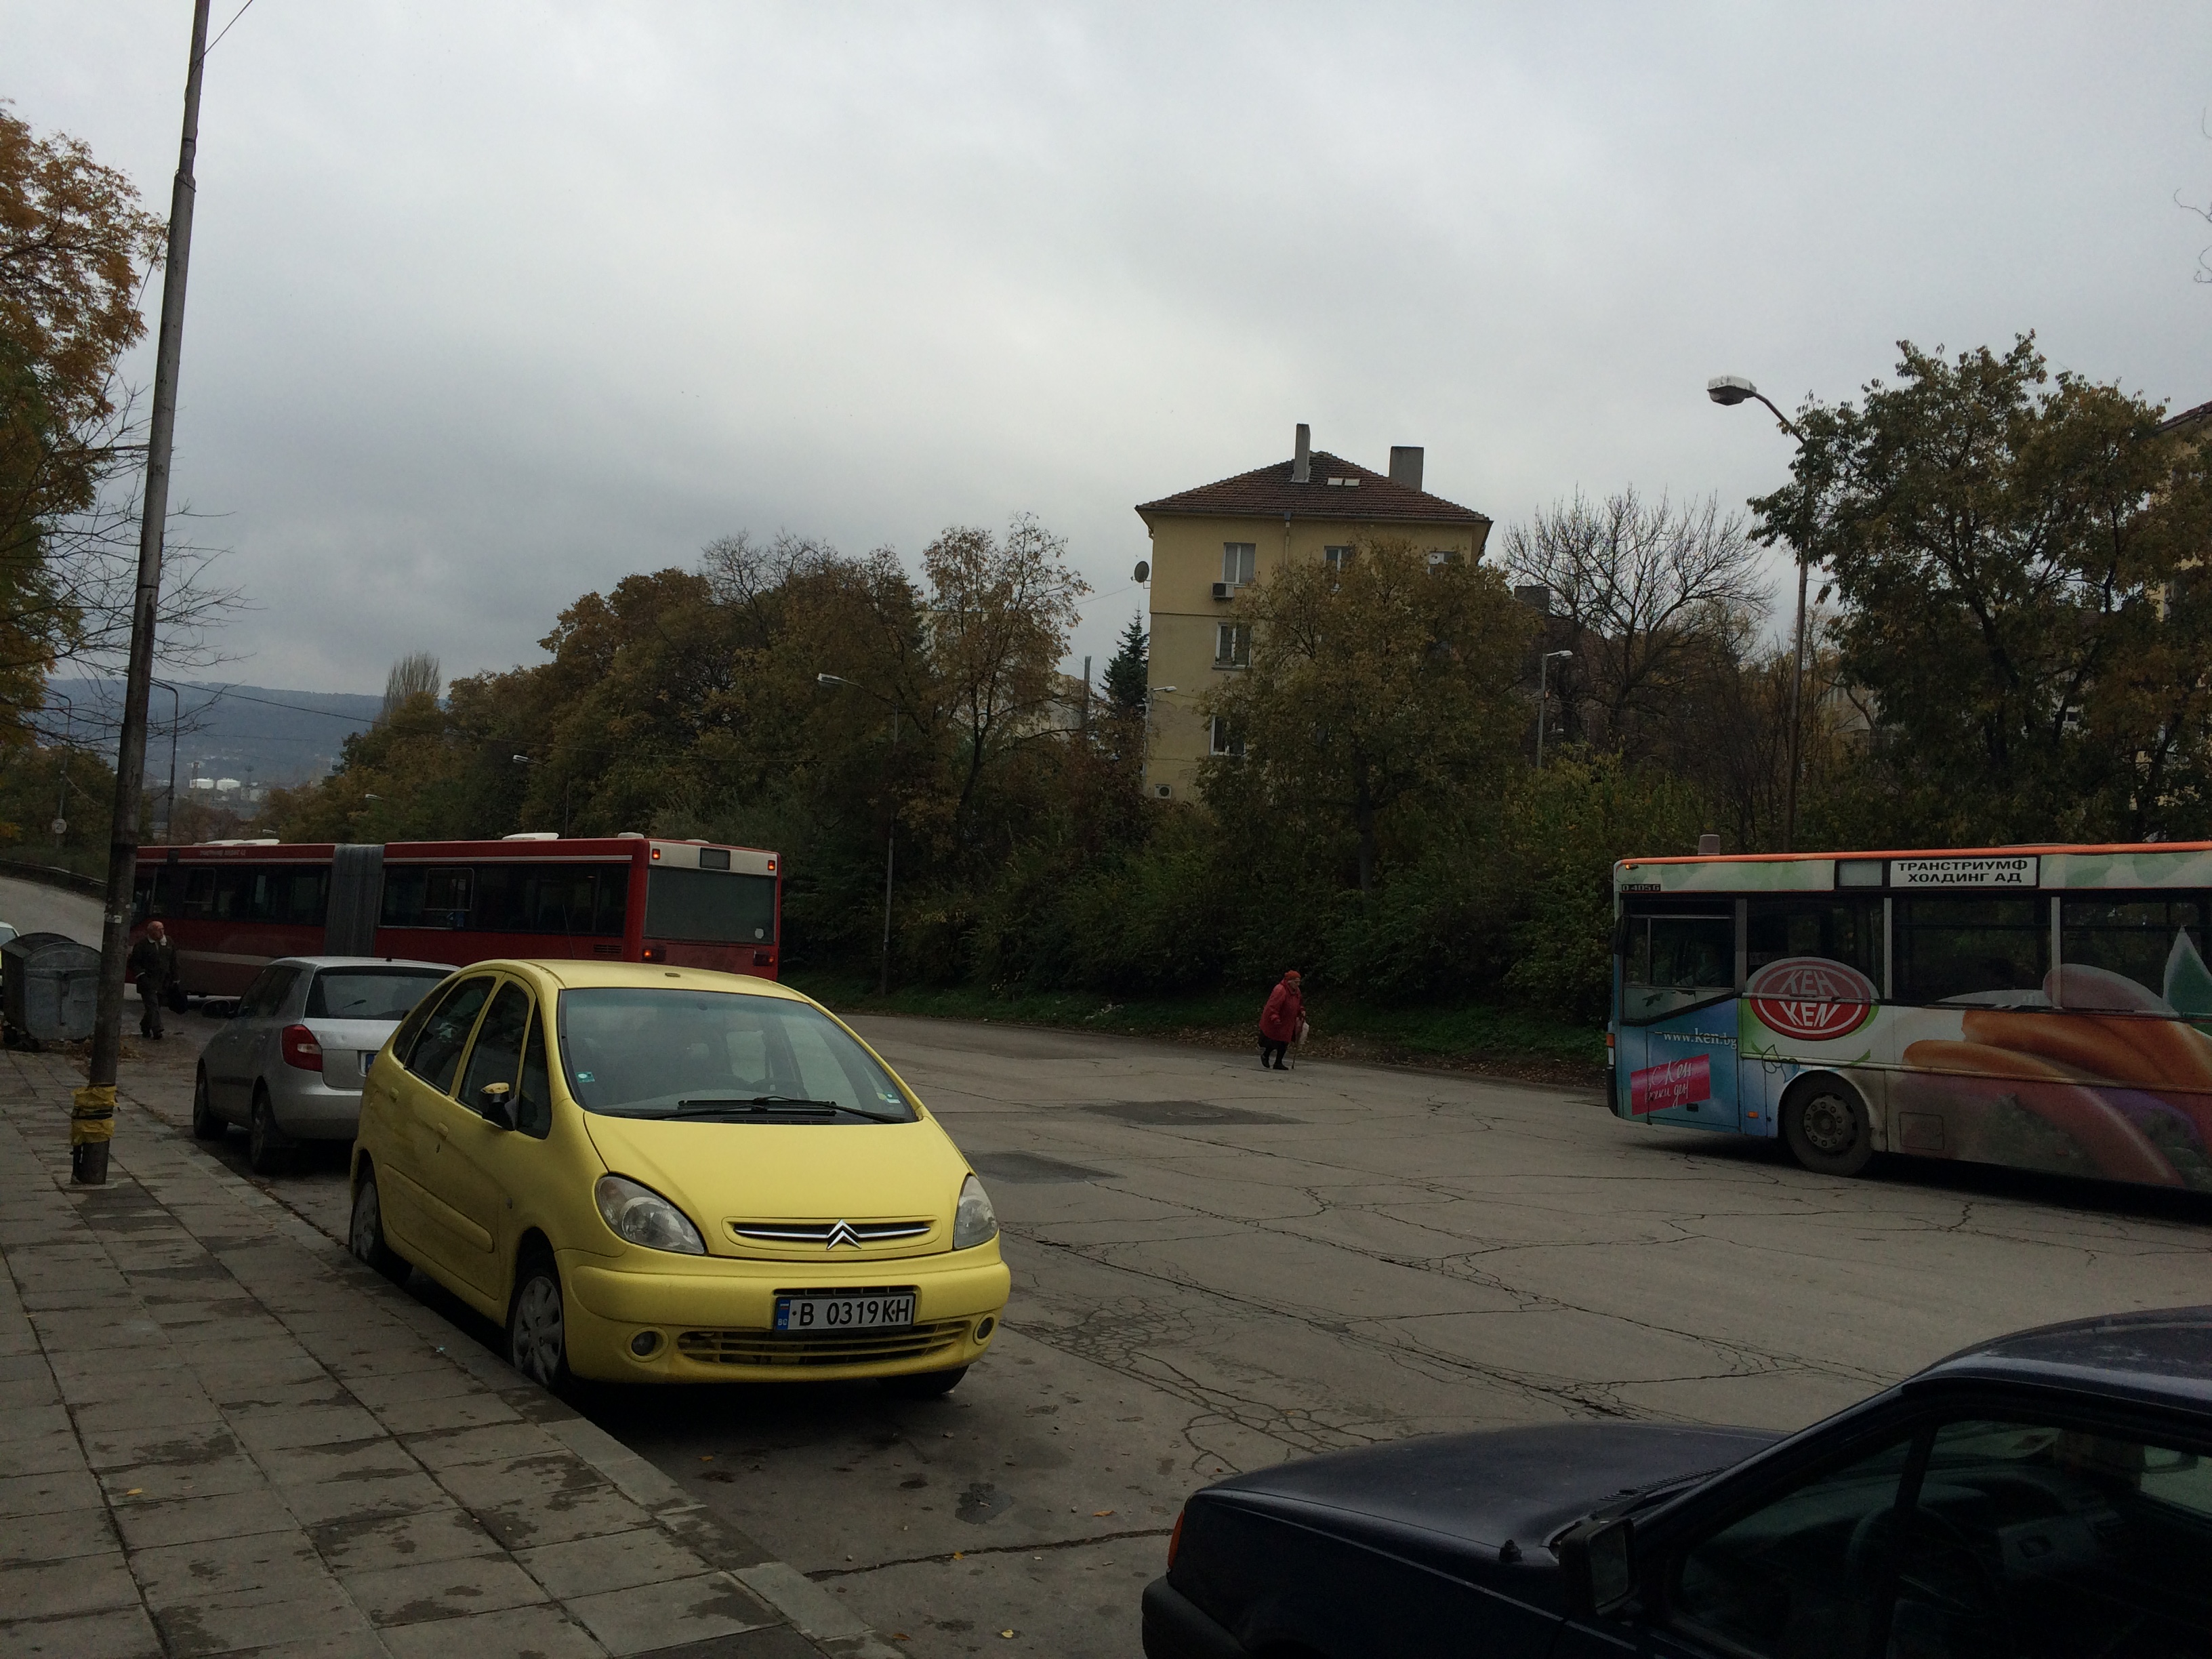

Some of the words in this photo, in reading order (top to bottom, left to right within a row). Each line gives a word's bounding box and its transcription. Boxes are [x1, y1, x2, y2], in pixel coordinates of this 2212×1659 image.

[1898, 859, 2028, 872] ТРАНСТРИУМФ
[1908, 873, 1990, 884] ХОЛДИНГ
[1994, 872, 2022, 883] АД
[1778, 969, 1841, 997] КЕН
[1778, 1000, 1841, 1027] KEN
[1664, 1027, 1738, 1050] www.ken.bg
